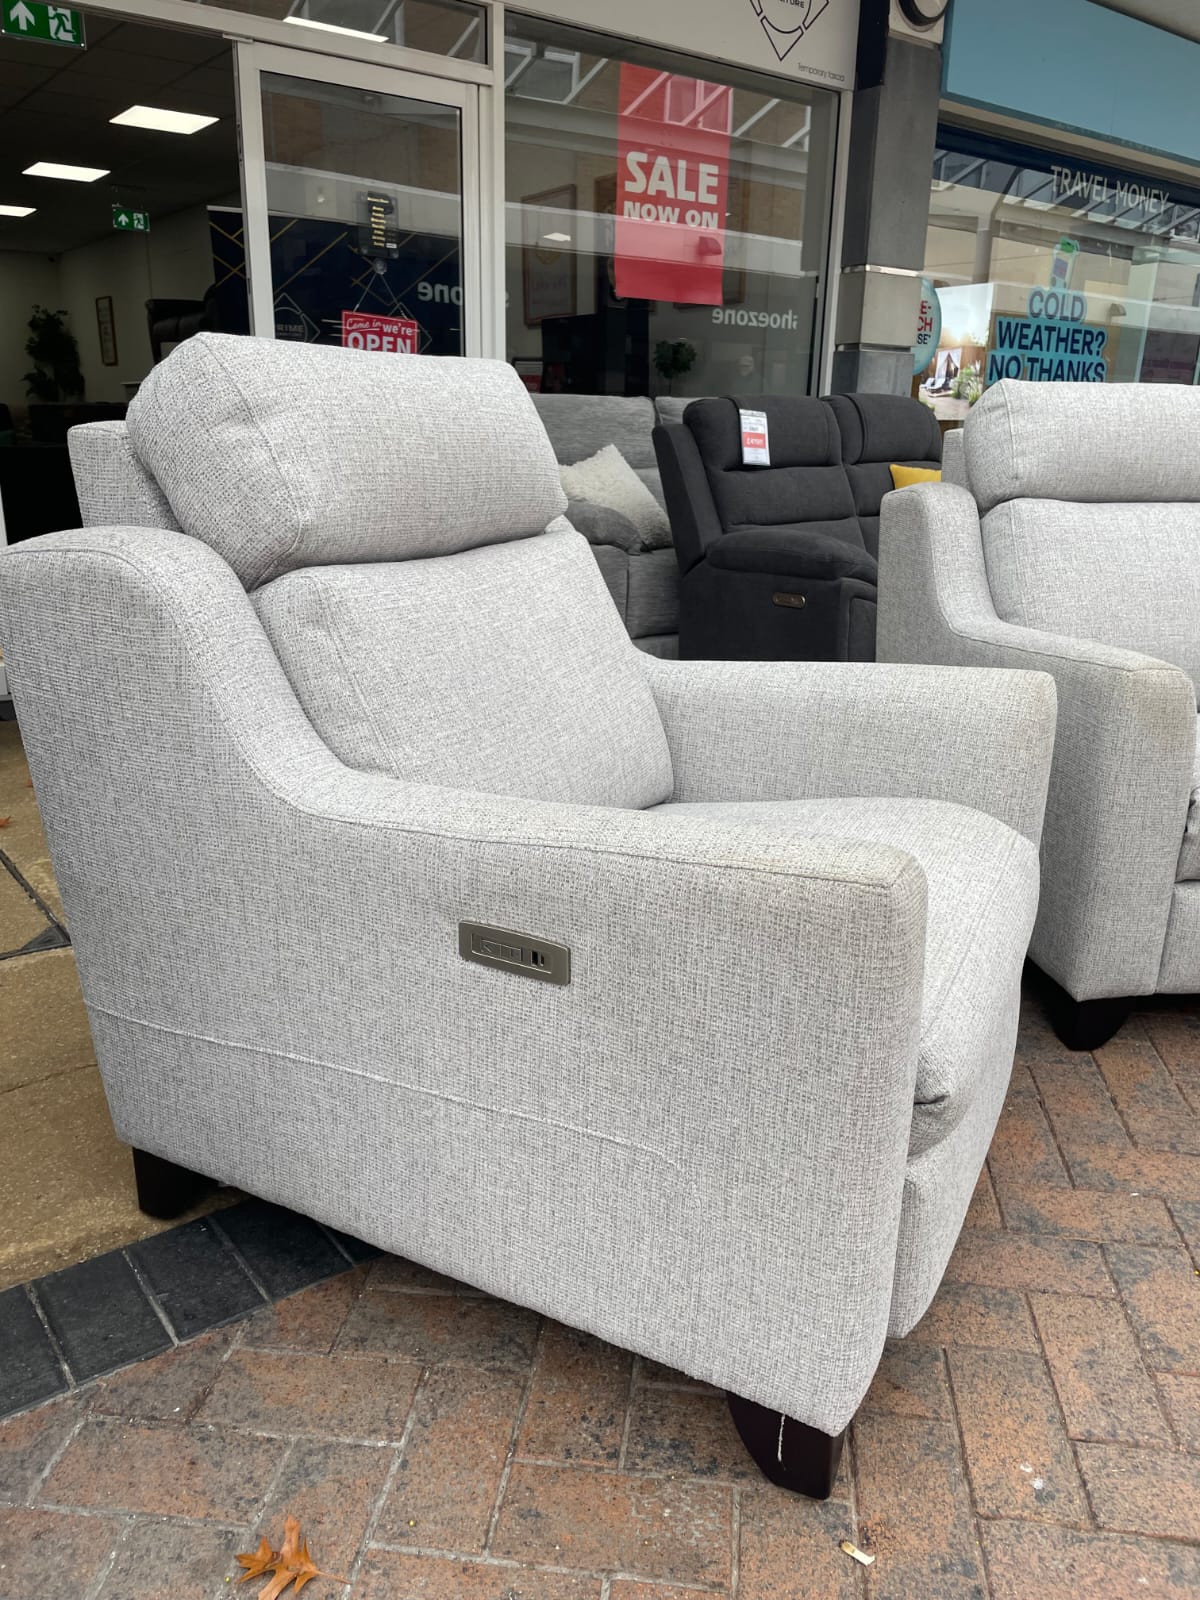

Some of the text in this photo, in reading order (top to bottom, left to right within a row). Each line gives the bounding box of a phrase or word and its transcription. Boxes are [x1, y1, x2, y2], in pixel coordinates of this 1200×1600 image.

[625, 151, 719, 205] SALE
[1051, 165, 1170, 213] TRAVEL MONEY
[623, 201, 719, 230] NOW ON
[1028, 290, 1085, 322] COLD
[276, 324, 305, 333] RIME
[346, 318, 413, 336] Come in we're
[998, 320, 1106, 357] WEATHER?
[348, 332, 411, 354] OPEN
[989, 354, 1105, 383] NO THANKS
